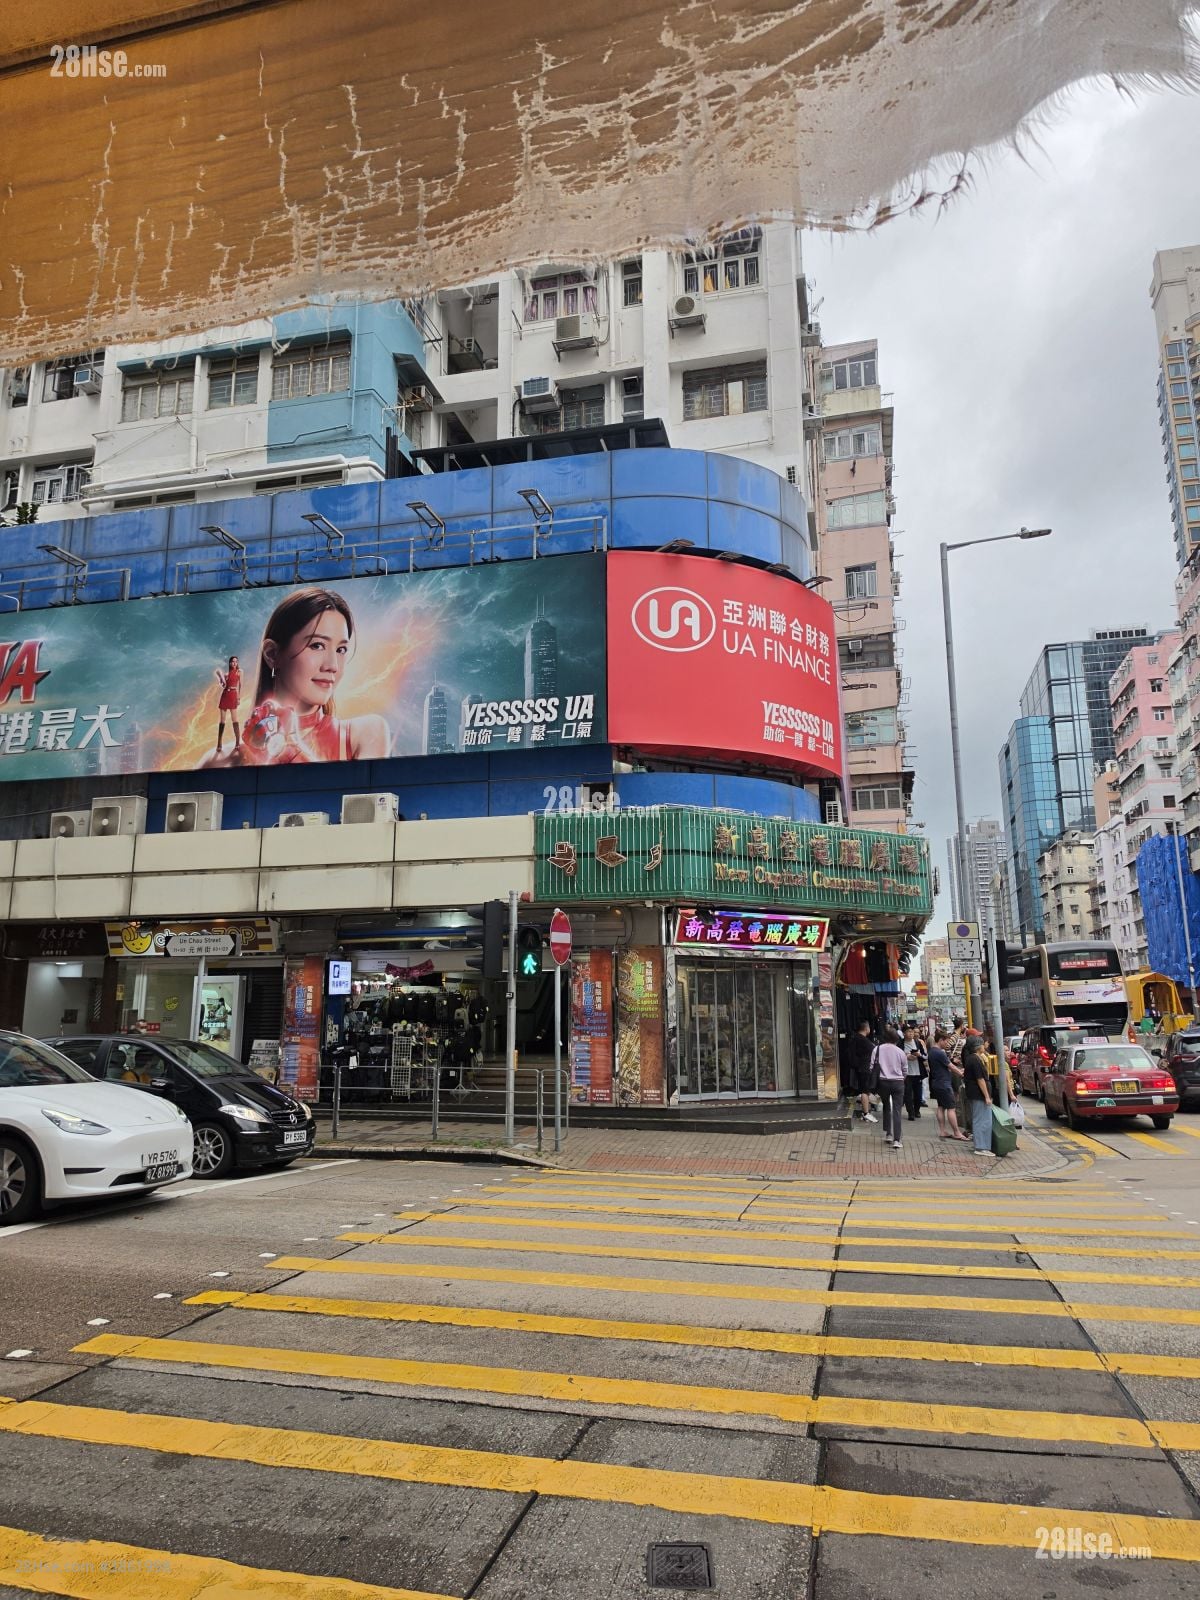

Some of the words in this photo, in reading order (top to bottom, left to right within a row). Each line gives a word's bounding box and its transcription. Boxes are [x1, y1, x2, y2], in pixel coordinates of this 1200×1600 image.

[648, 598, 700, 642] UA
[723, 599, 830, 658] 亞洲聯合財務
[722, 629, 757, 658] UA
[763, 638, 831, 685] FINANCE
[463, 697, 560, 728] YESSSSSS
[564, 694, 595, 721] UA
[761, 700, 820, 738] YESSSSSS
[821, 718, 834, 744] UA
[463, 726, 523, 746] 助你一臂
[531, 721, 593, 741] 鬆一口氣
[714, 822, 920, 875] 新高登電腦廣場
[714, 862, 749, 882] New
[685, 917, 821, 946] 新高登電腦廣場
[148, 1152, 159, 1164] YR
[160, 1149, 178, 1162] 5760
